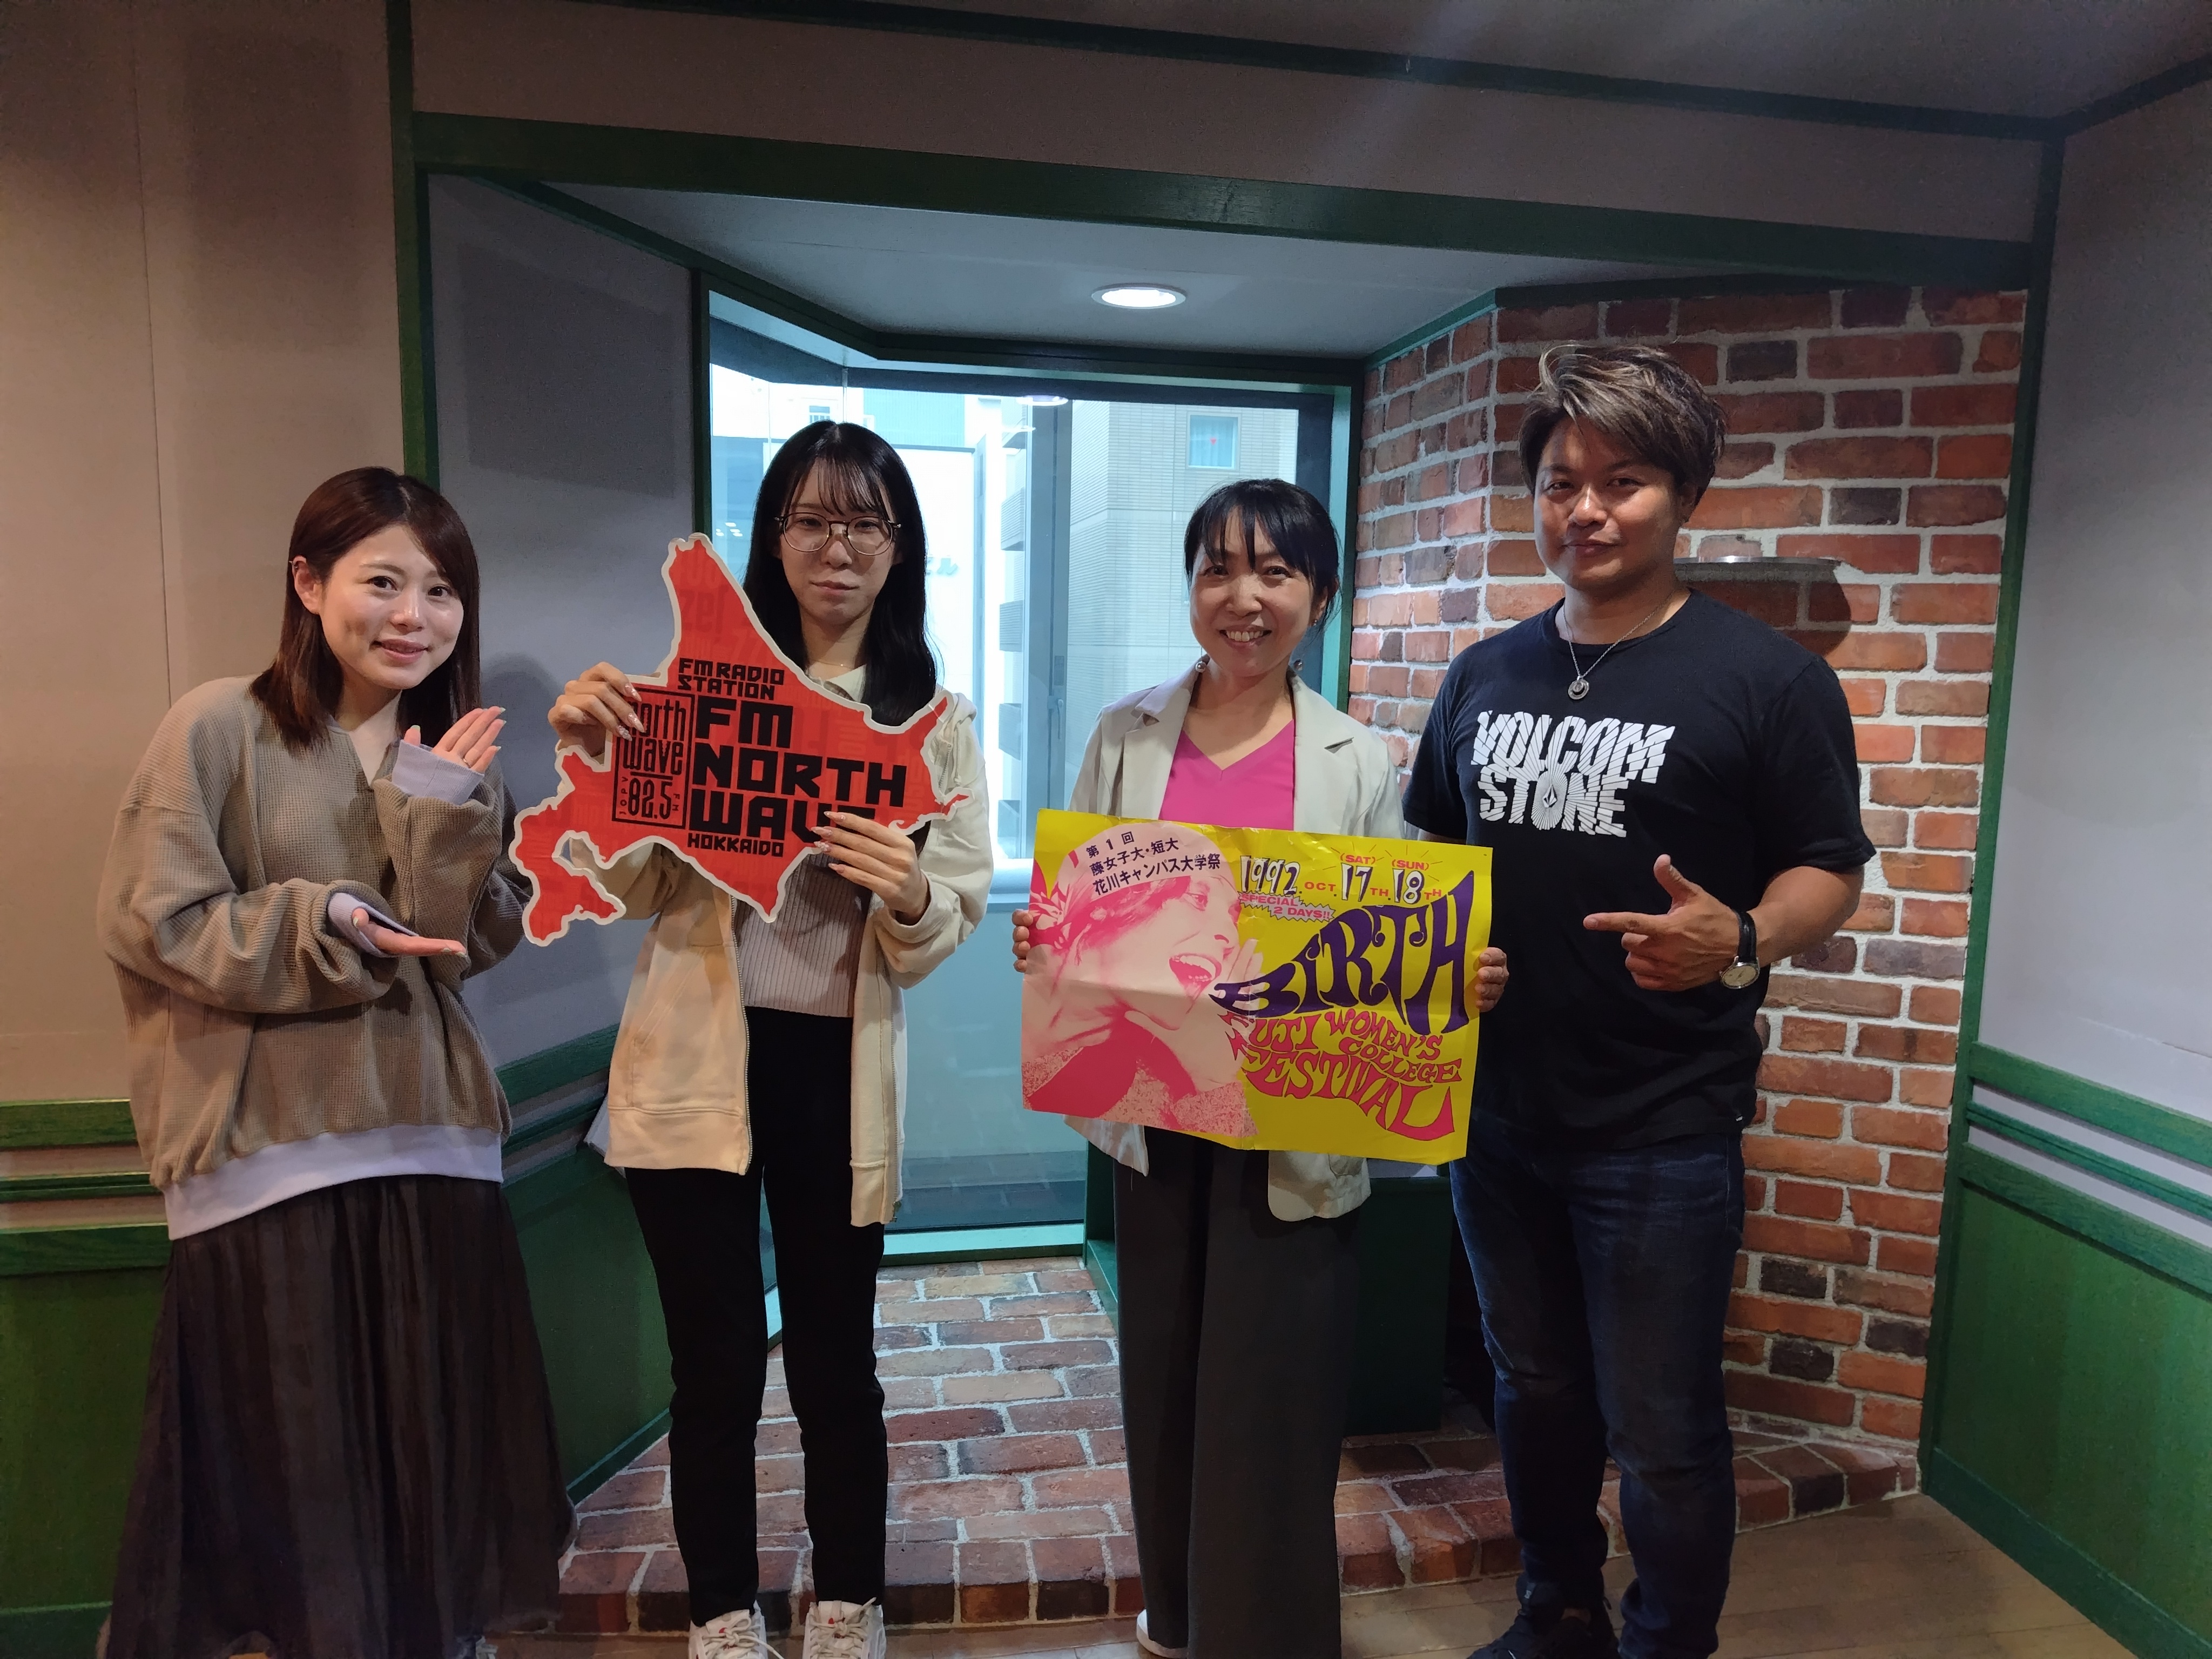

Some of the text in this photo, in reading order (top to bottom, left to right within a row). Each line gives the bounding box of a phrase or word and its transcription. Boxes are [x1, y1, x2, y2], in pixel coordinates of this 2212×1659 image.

[677, 674, 775, 700] STATION
[678, 657, 785, 685] FM RADIO
[694, 694, 793, 748] FM
[623, 737, 684, 775] wave
[1470, 710, 1675, 784] VOLCOM
[692, 742, 907, 808] NORTH
[628, 778, 673, 820] 82.5
[1477, 761, 1628, 838] STONE
[687, 833, 784, 858] HOKKAIDO
[1092, 853, 1220, 895] 花川キャンパス大学祭
[1240, 893, 1299, 907] SPECIAL
[1273, 906, 1331, 919] 2 DAYS!!
[1208, 870, 1475, 1035] BIRTH
[1324, 1008, 1443, 1061] WOMEN'S
[1338, 1037, 1462, 1083] COLLEGE
[1224, 1027, 1455, 1141] FESTIVAL
